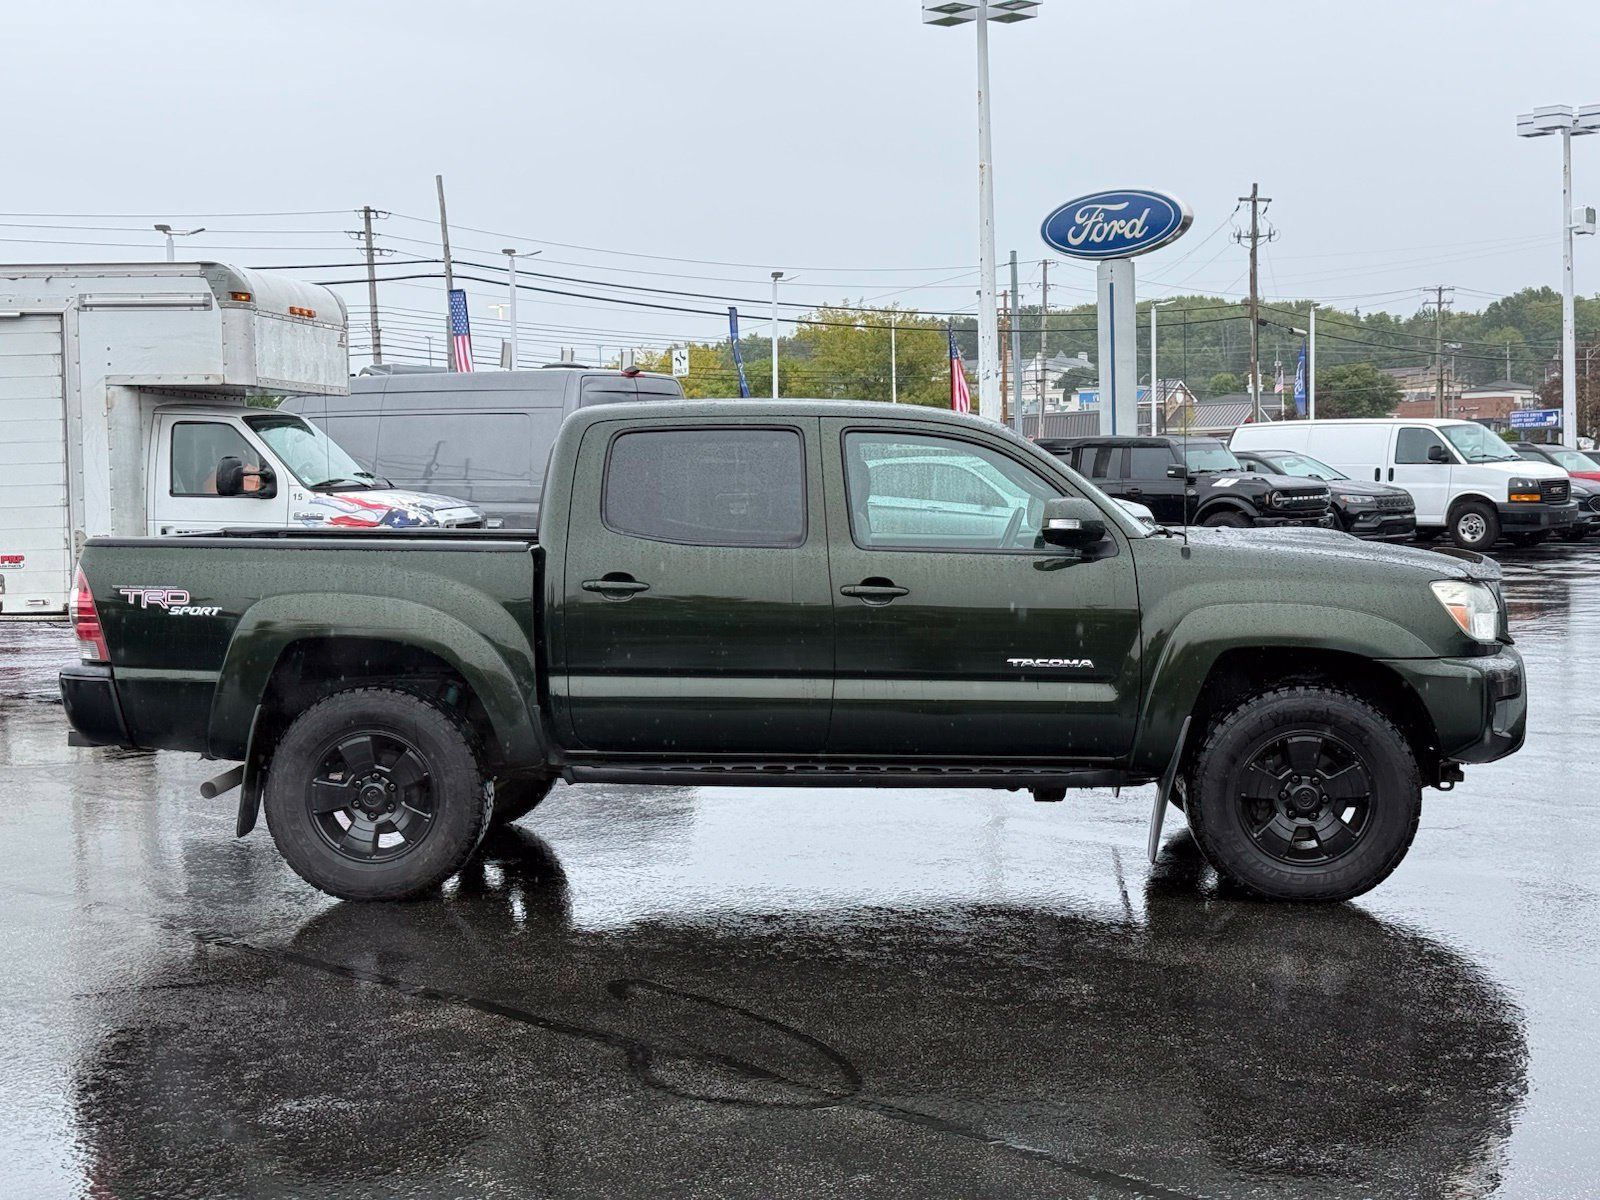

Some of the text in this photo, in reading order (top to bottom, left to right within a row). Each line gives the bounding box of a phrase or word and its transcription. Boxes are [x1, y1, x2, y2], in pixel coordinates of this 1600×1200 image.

[1067, 201, 1151, 246] Ford
[120, 588, 190, 609] TRD
[168, 605, 222, 616] SPORT
[1006, 657, 1095, 669] TACOMA
